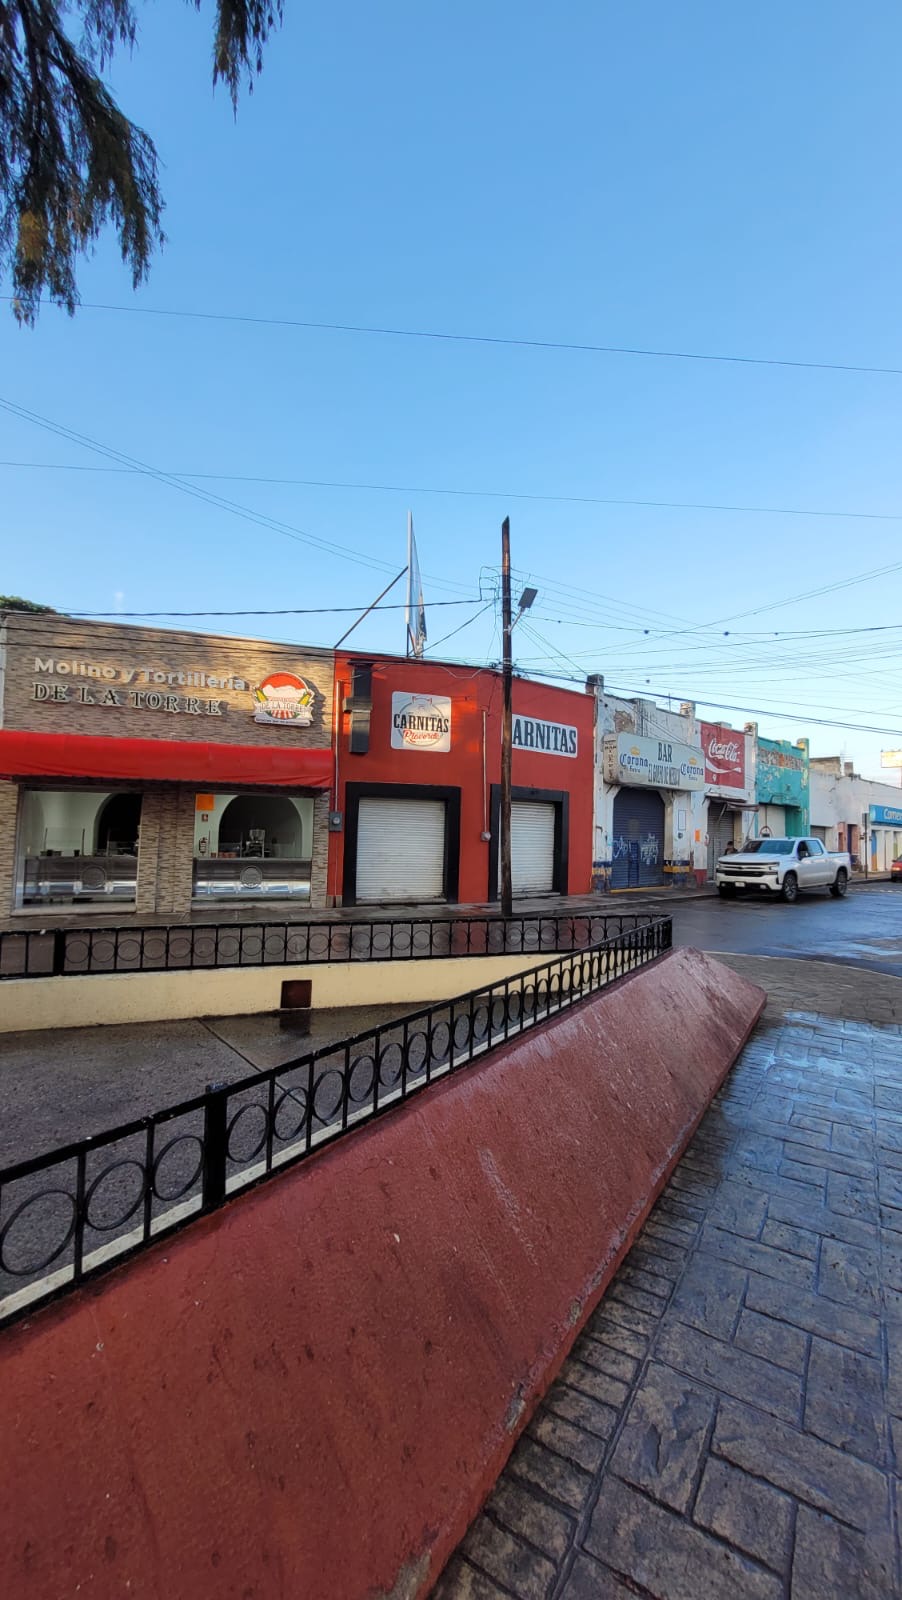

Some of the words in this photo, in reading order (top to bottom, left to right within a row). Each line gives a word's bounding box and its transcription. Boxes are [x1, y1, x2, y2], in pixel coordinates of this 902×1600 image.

[34, 657, 116, 679] Molino
[123, 668, 137, 683] y
[31, 682, 70, 703] DE
[79, 685, 124, 707] LA
[128, 690, 222, 716] TORRE
[393, 713, 449, 733] CARNITAS
[512, 718, 577, 754] ARNITAS
[619, 753, 649, 768] Corona
[657, 742, 673, 763] BAR
[680, 762, 704, 776] Corona
